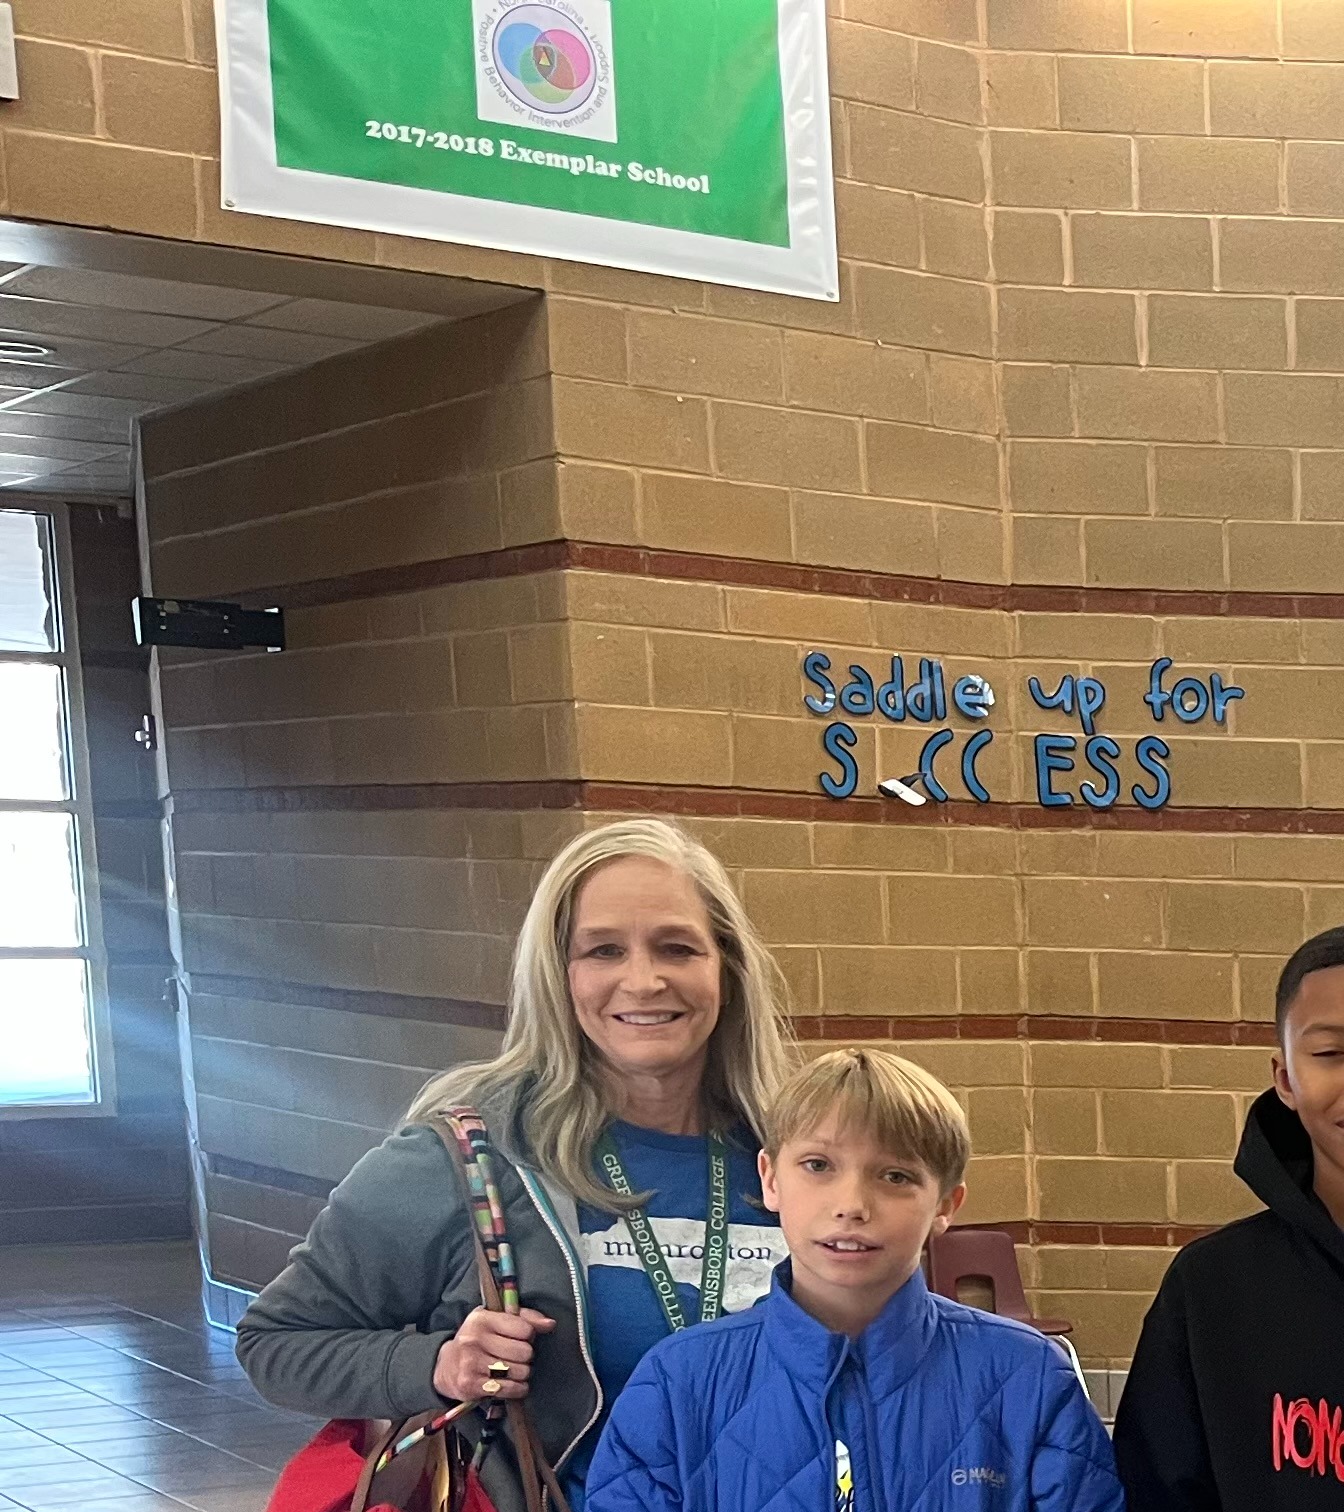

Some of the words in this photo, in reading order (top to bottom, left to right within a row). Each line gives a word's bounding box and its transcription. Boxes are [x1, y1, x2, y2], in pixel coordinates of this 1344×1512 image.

[484, 66, 526, 117] Behavior
[528, 107, 597, 128] Intervention
[595, 86, 608, 109] and
[365, 120, 495, 157] 2017-2018
[499, 139, 622, 176] Exemplar
[627, 161, 711, 194] School
[803, 650, 994, 722] Saddle
[1028, 674, 1106, 734] up
[1144, 656, 1246, 724] for
[818, 722, 1172, 810] SCCESS
[711, 1155, 726, 1231] COLLEGE
[603, 1153, 660, 1265] GREESBORO
[653, 1270, 686, 1333] COLLE
[604, 1240, 772, 1260] mnroton
